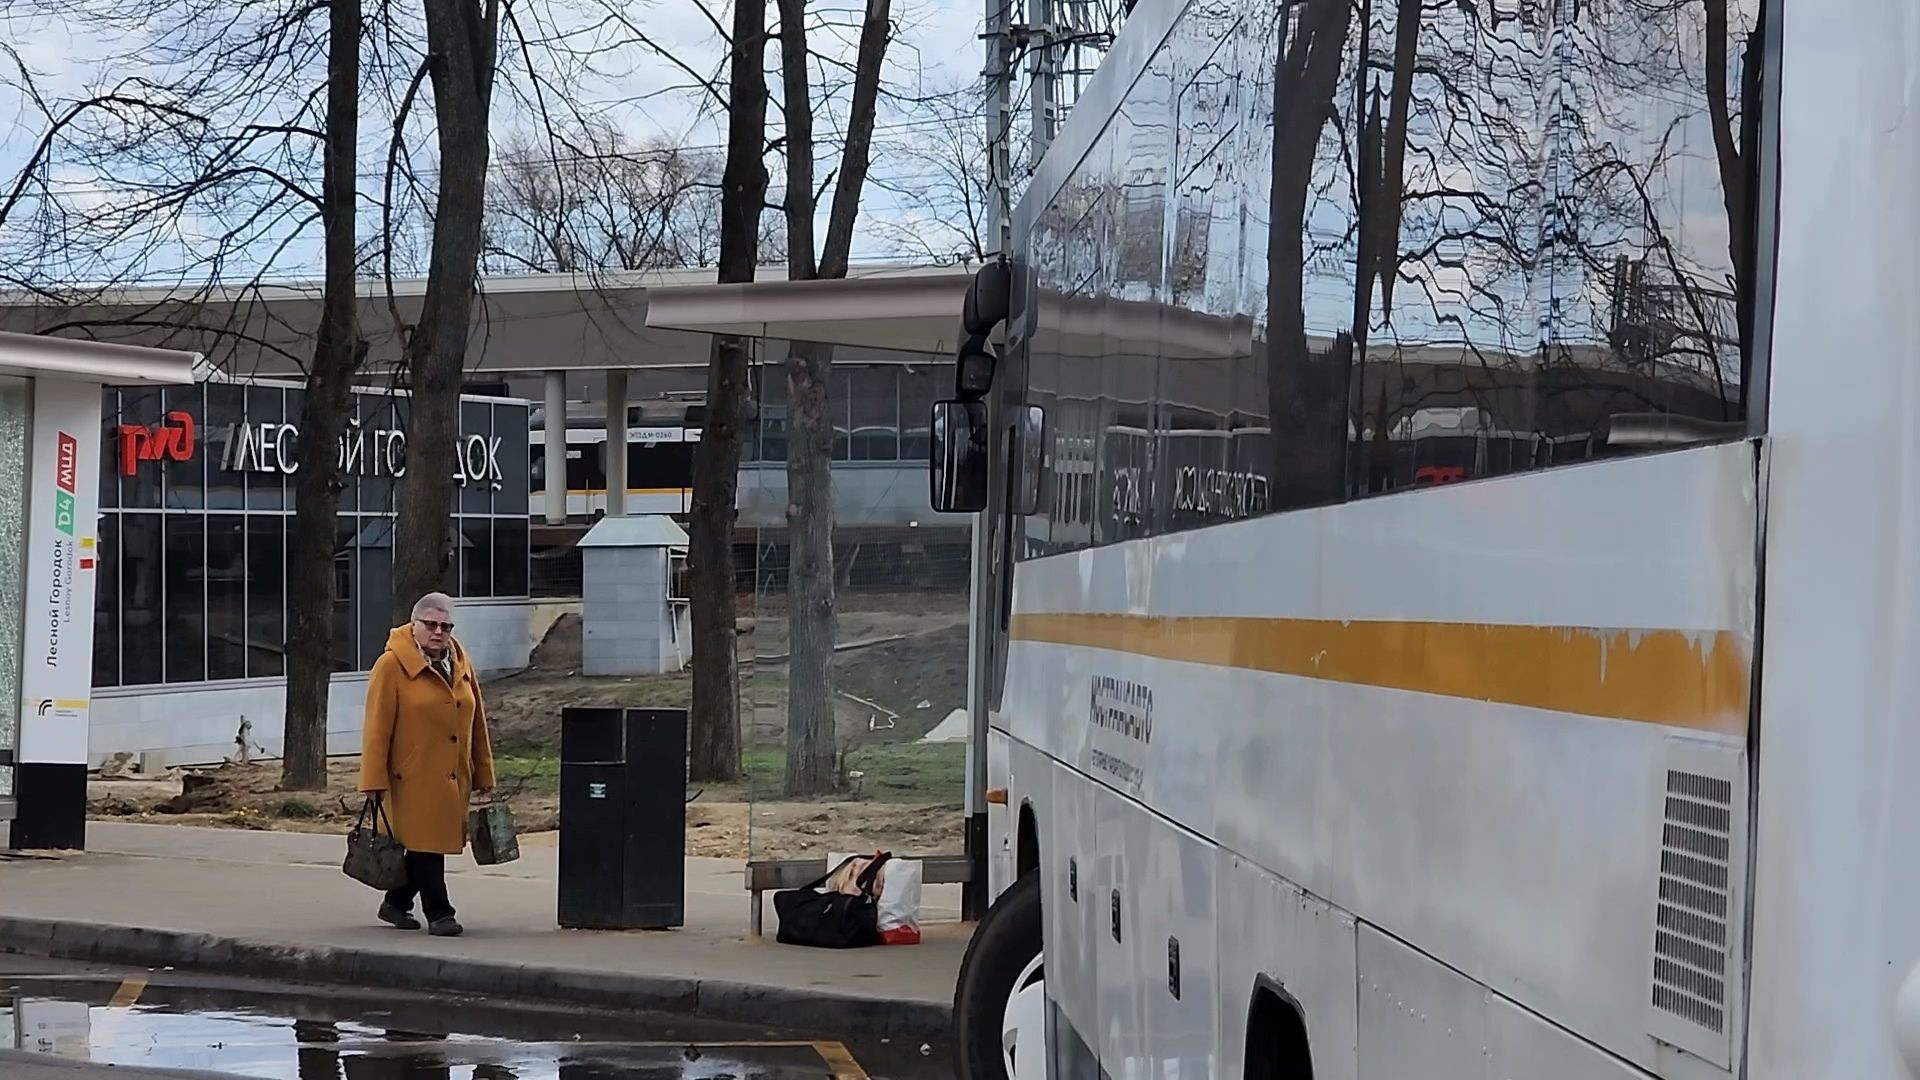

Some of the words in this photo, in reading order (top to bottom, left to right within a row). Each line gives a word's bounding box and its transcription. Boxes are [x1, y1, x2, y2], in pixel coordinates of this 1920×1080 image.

[60, 442, 73, 486] МЦД
[238, 415, 364, 476] ЛЕСЙ
[374, 429, 503, 488] ГОДОК
[58, 498, 72, 526] D4
[49, 539, 63, 604] Городок
[64, 540, 74, 585] Gorodok
[63, 588, 73, 623] Lesnoy
[46, 608, 60, 668] Лесной
